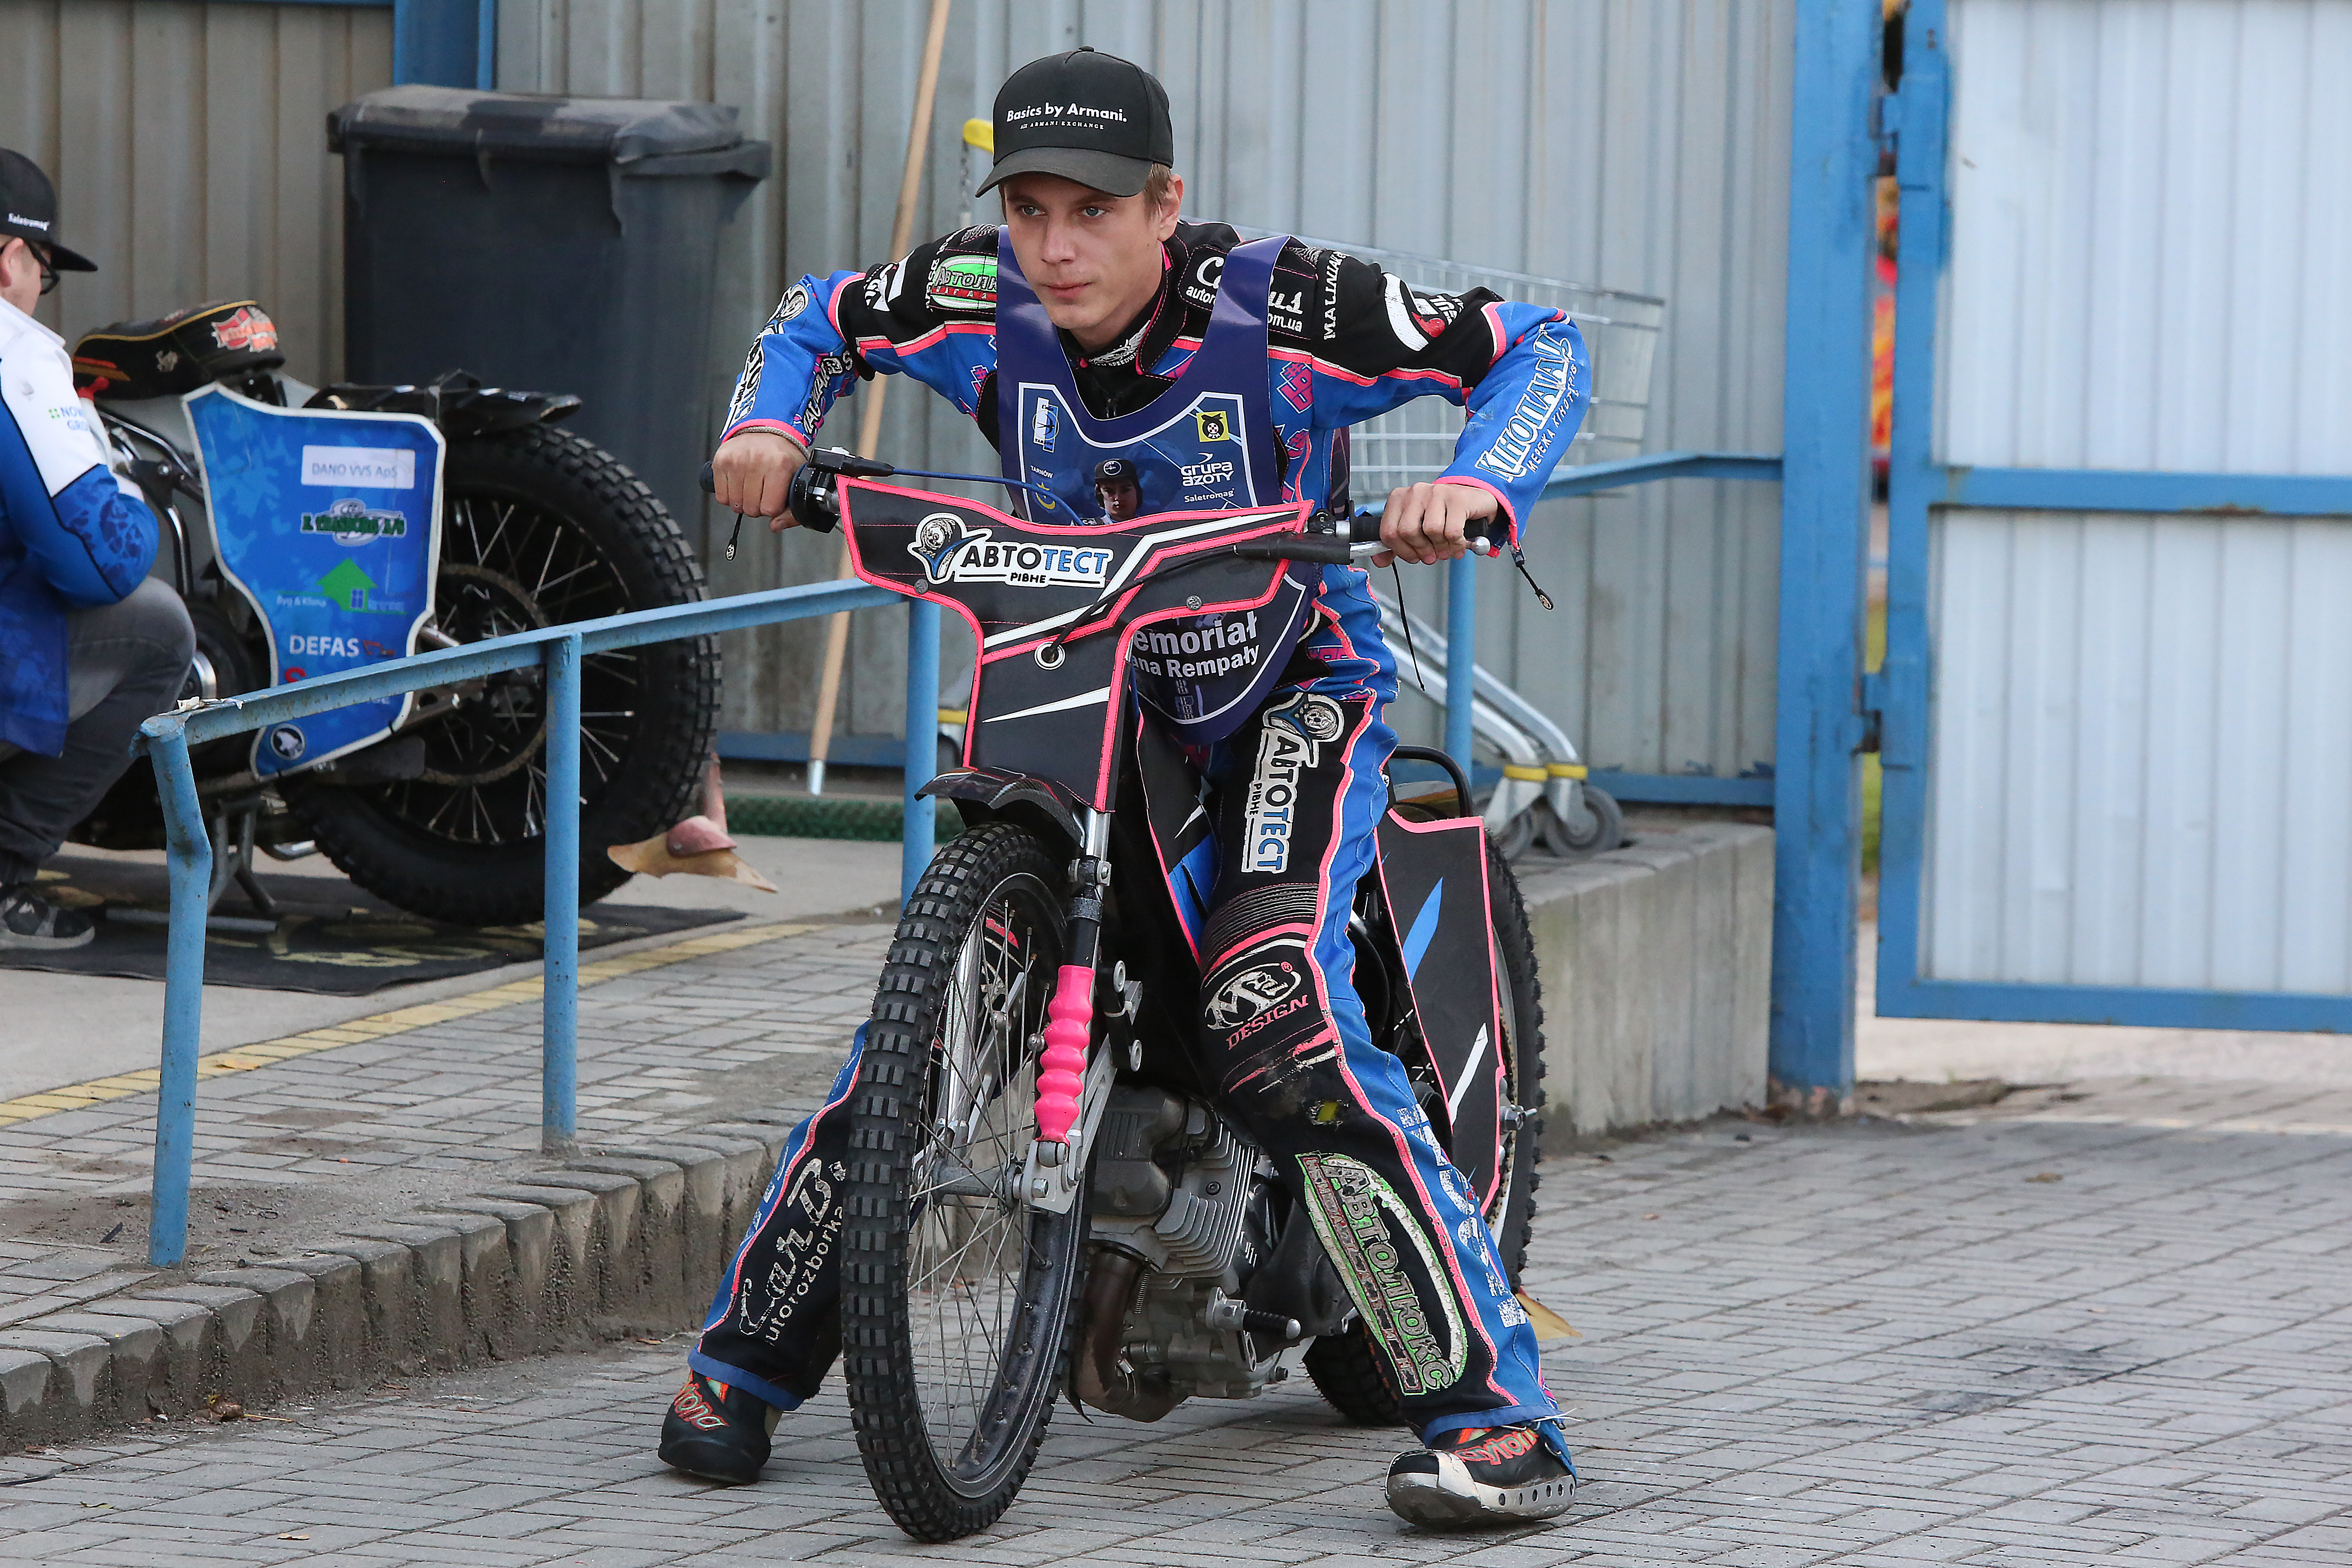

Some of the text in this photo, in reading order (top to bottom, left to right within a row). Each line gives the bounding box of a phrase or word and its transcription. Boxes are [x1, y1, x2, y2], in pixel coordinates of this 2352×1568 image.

[1006, 102, 1128, 122] Basics by Armani.
[1061, 121, 1104, 130] EXCHANGE
[1526, 428, 1556, 473] МЕРЕЖА
[1030, 465, 1053, 479] TARNÓW
[1184, 488, 1234, 503] Saletromag
[960, 546, 1109, 574] АВТОТЕСТ
[1010, 572, 1047, 584] РІВНЕ
[289, 635, 360, 657] DEFAS
[1166, 644, 1260, 678] Rempały
[1249, 782, 1263, 816] РІВНЕ
[1256, 734, 1301, 871] АВТОТЕСТ
[1226, 994, 1309, 1051] DESIGN
